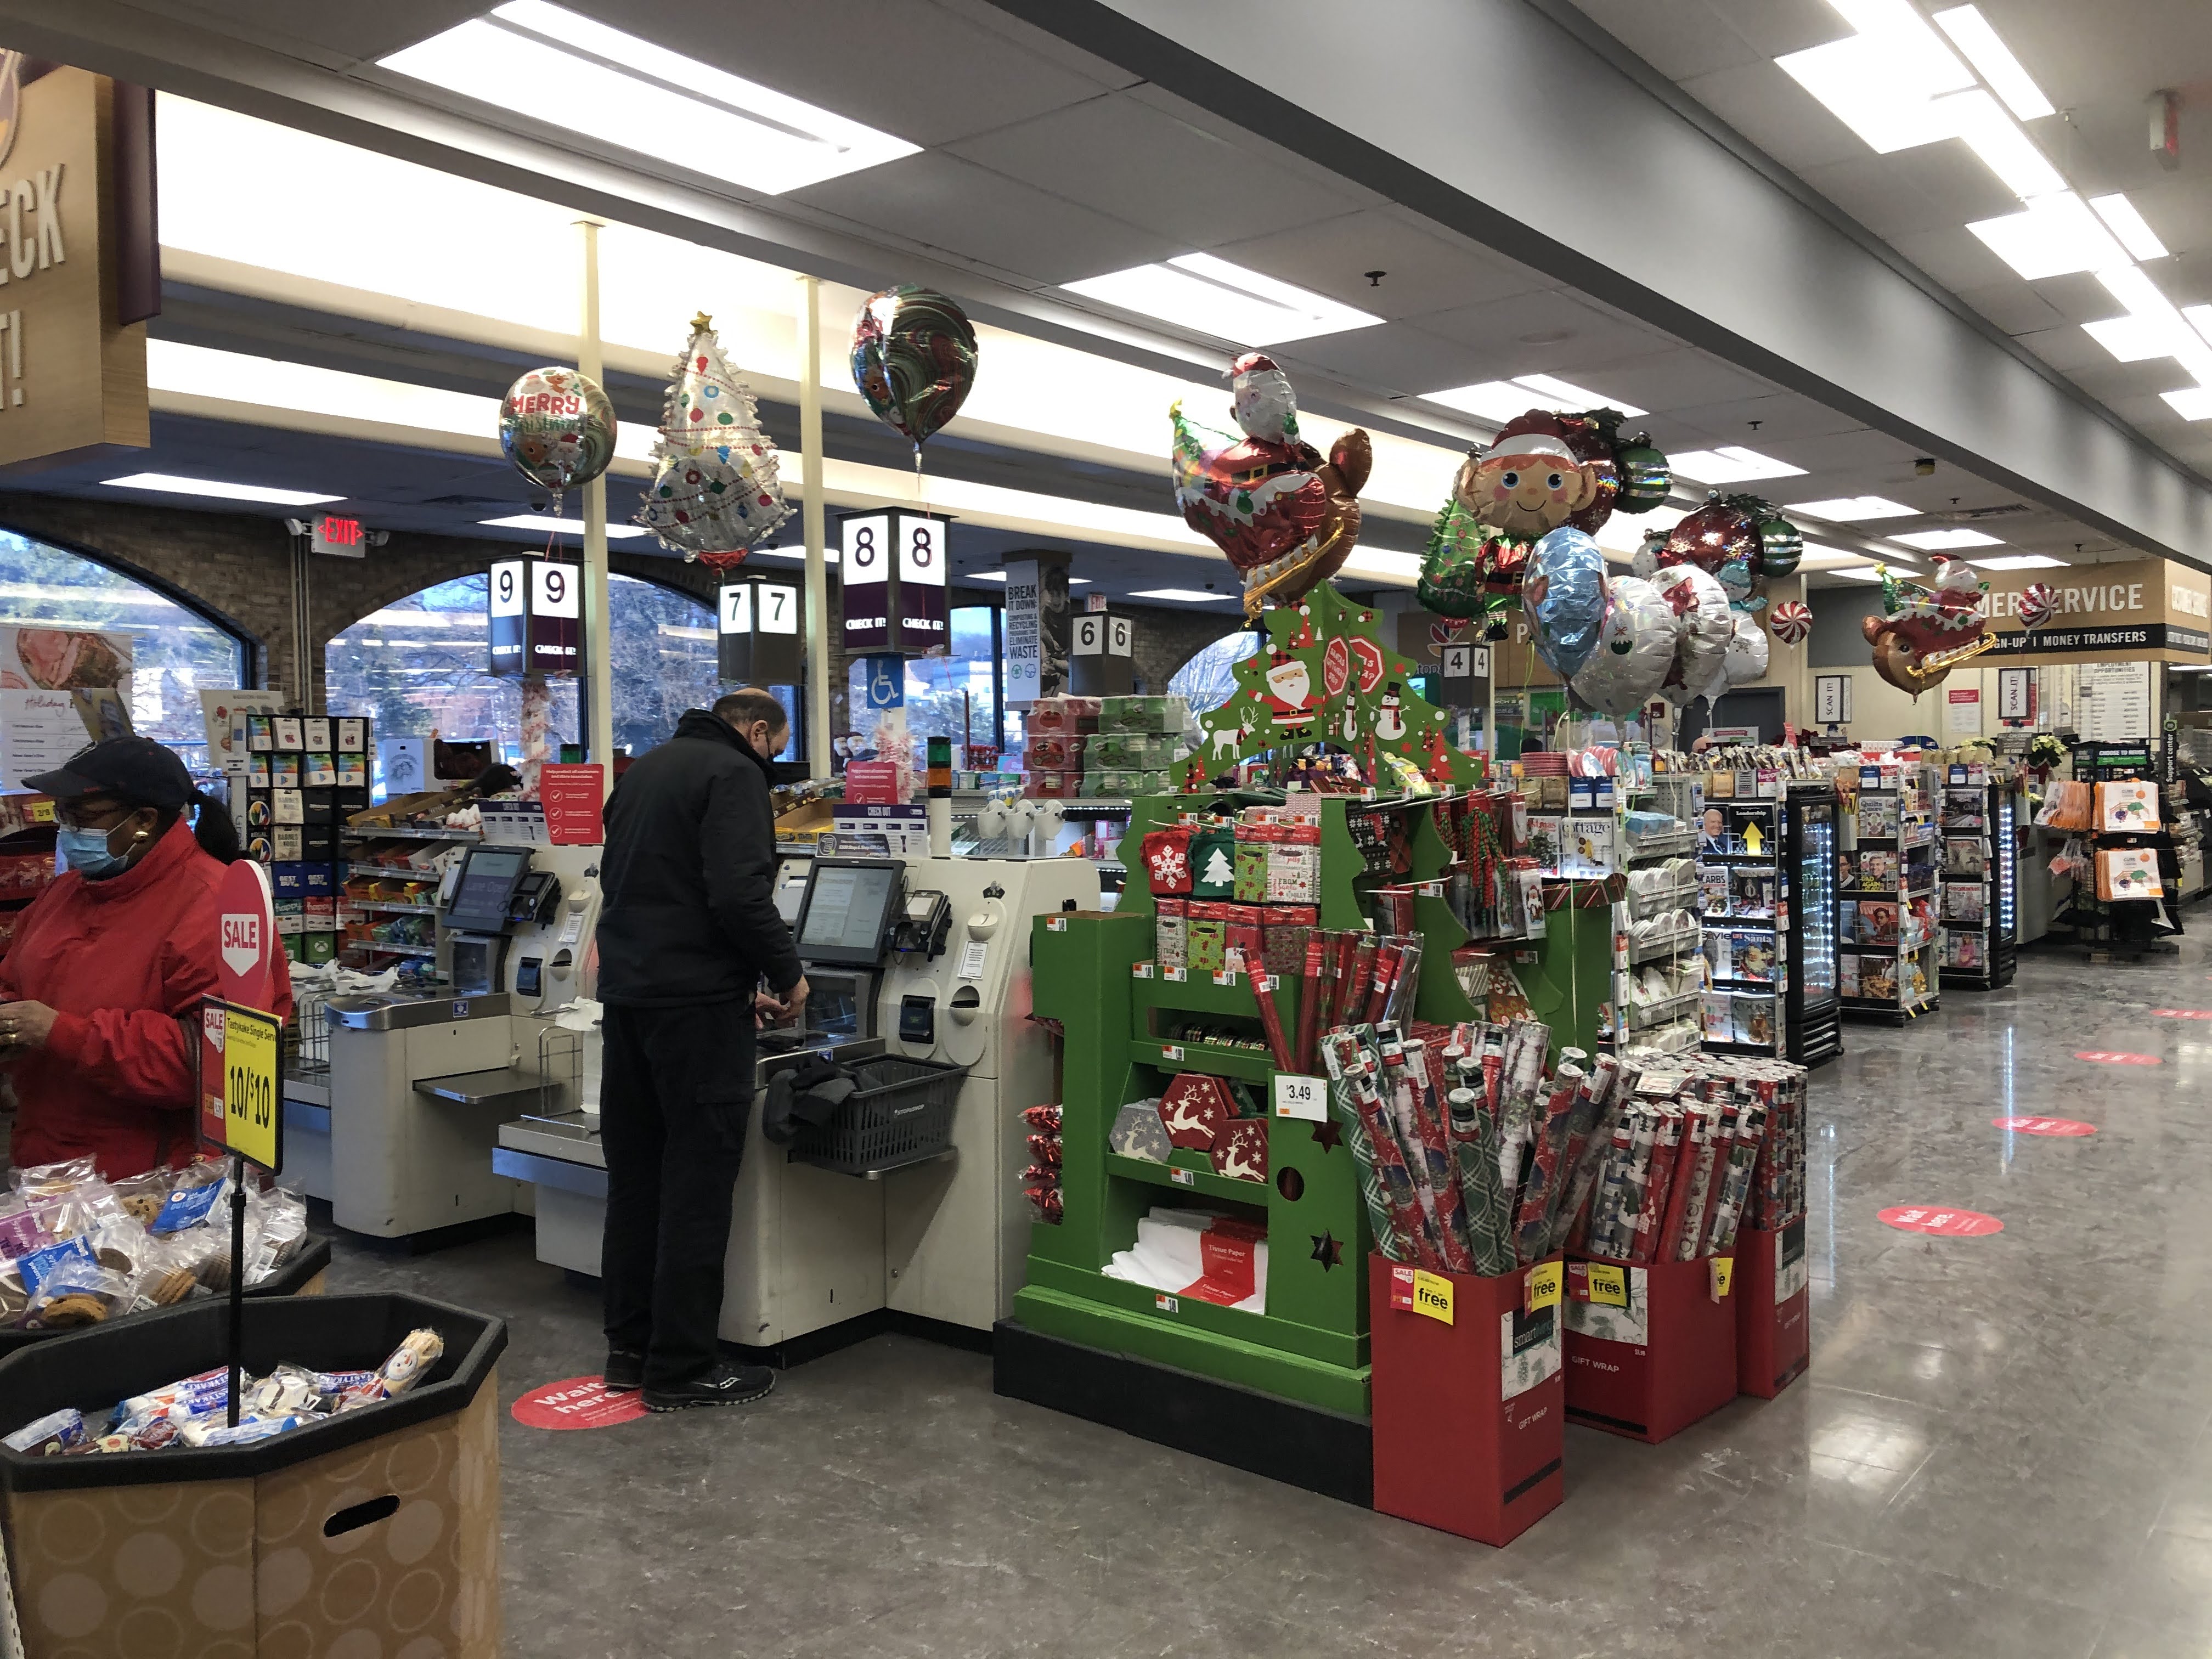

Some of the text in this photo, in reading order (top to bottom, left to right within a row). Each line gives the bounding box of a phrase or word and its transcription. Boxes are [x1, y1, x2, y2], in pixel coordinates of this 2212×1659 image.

[510, 393, 580, 415] MERRY
[325, 517, 359, 546] EXIT
[855, 527, 874, 567] 8
[912, 527, 932, 567] 8
[500, 570, 513, 603] 9
[545, 570, 565, 603] 9
[1008, 584, 1037, 600] BREAK
[729, 592, 741, 620] 7
[771, 592, 785, 621] 7
[1008, 601, 1014, 611] IT
[2052, 583, 2143, 614] ERVICE
[846, 617, 887, 630] CHECK IT!
[902, 618, 944, 630] CHECK IT!
[1009, 620, 1037, 630] RECYCLING
[1009, 635, 1037, 646] ELIMINATE
[1081, 622, 1094, 646] 6
[1116, 623, 1125, 646] 6
[1517, 623, 1528, 644] P
[2043, 634, 2080, 647] MONEY
[2083, 631, 2147, 645] TRANSFERS
[535, 645, 577, 655] CHECK IT!
[1009, 645, 1037, 659] WASTE
[1451, 652, 1463, 669] 4
[1478, 652, 1485, 670] 4
[223, 920, 257, 949] SALE
[1744, 934, 1773, 943] Santa
[206, 1012, 223, 1030] SALE
[227, 1018, 250, 1034] Tastykake
[250, 1024, 264, 1040] Single
[230, 1065, 270, 1129] 10/$10
[1286, 1085, 1311, 1101] $3.49
[1895, 1210, 1928, 1223] Wait
[1209, 1244, 1246, 1257] Tissue Paper
[1533, 1279, 1556, 1298] free
[1593, 1279, 1621, 1295] free
[1419, 1288, 1448, 1309] free
[1571, 1355, 1620, 1373] GIFT WRAP
[534, 1382, 607, 1406] Wait
[1519, 1406, 1548, 1430] GIFT WRAP
